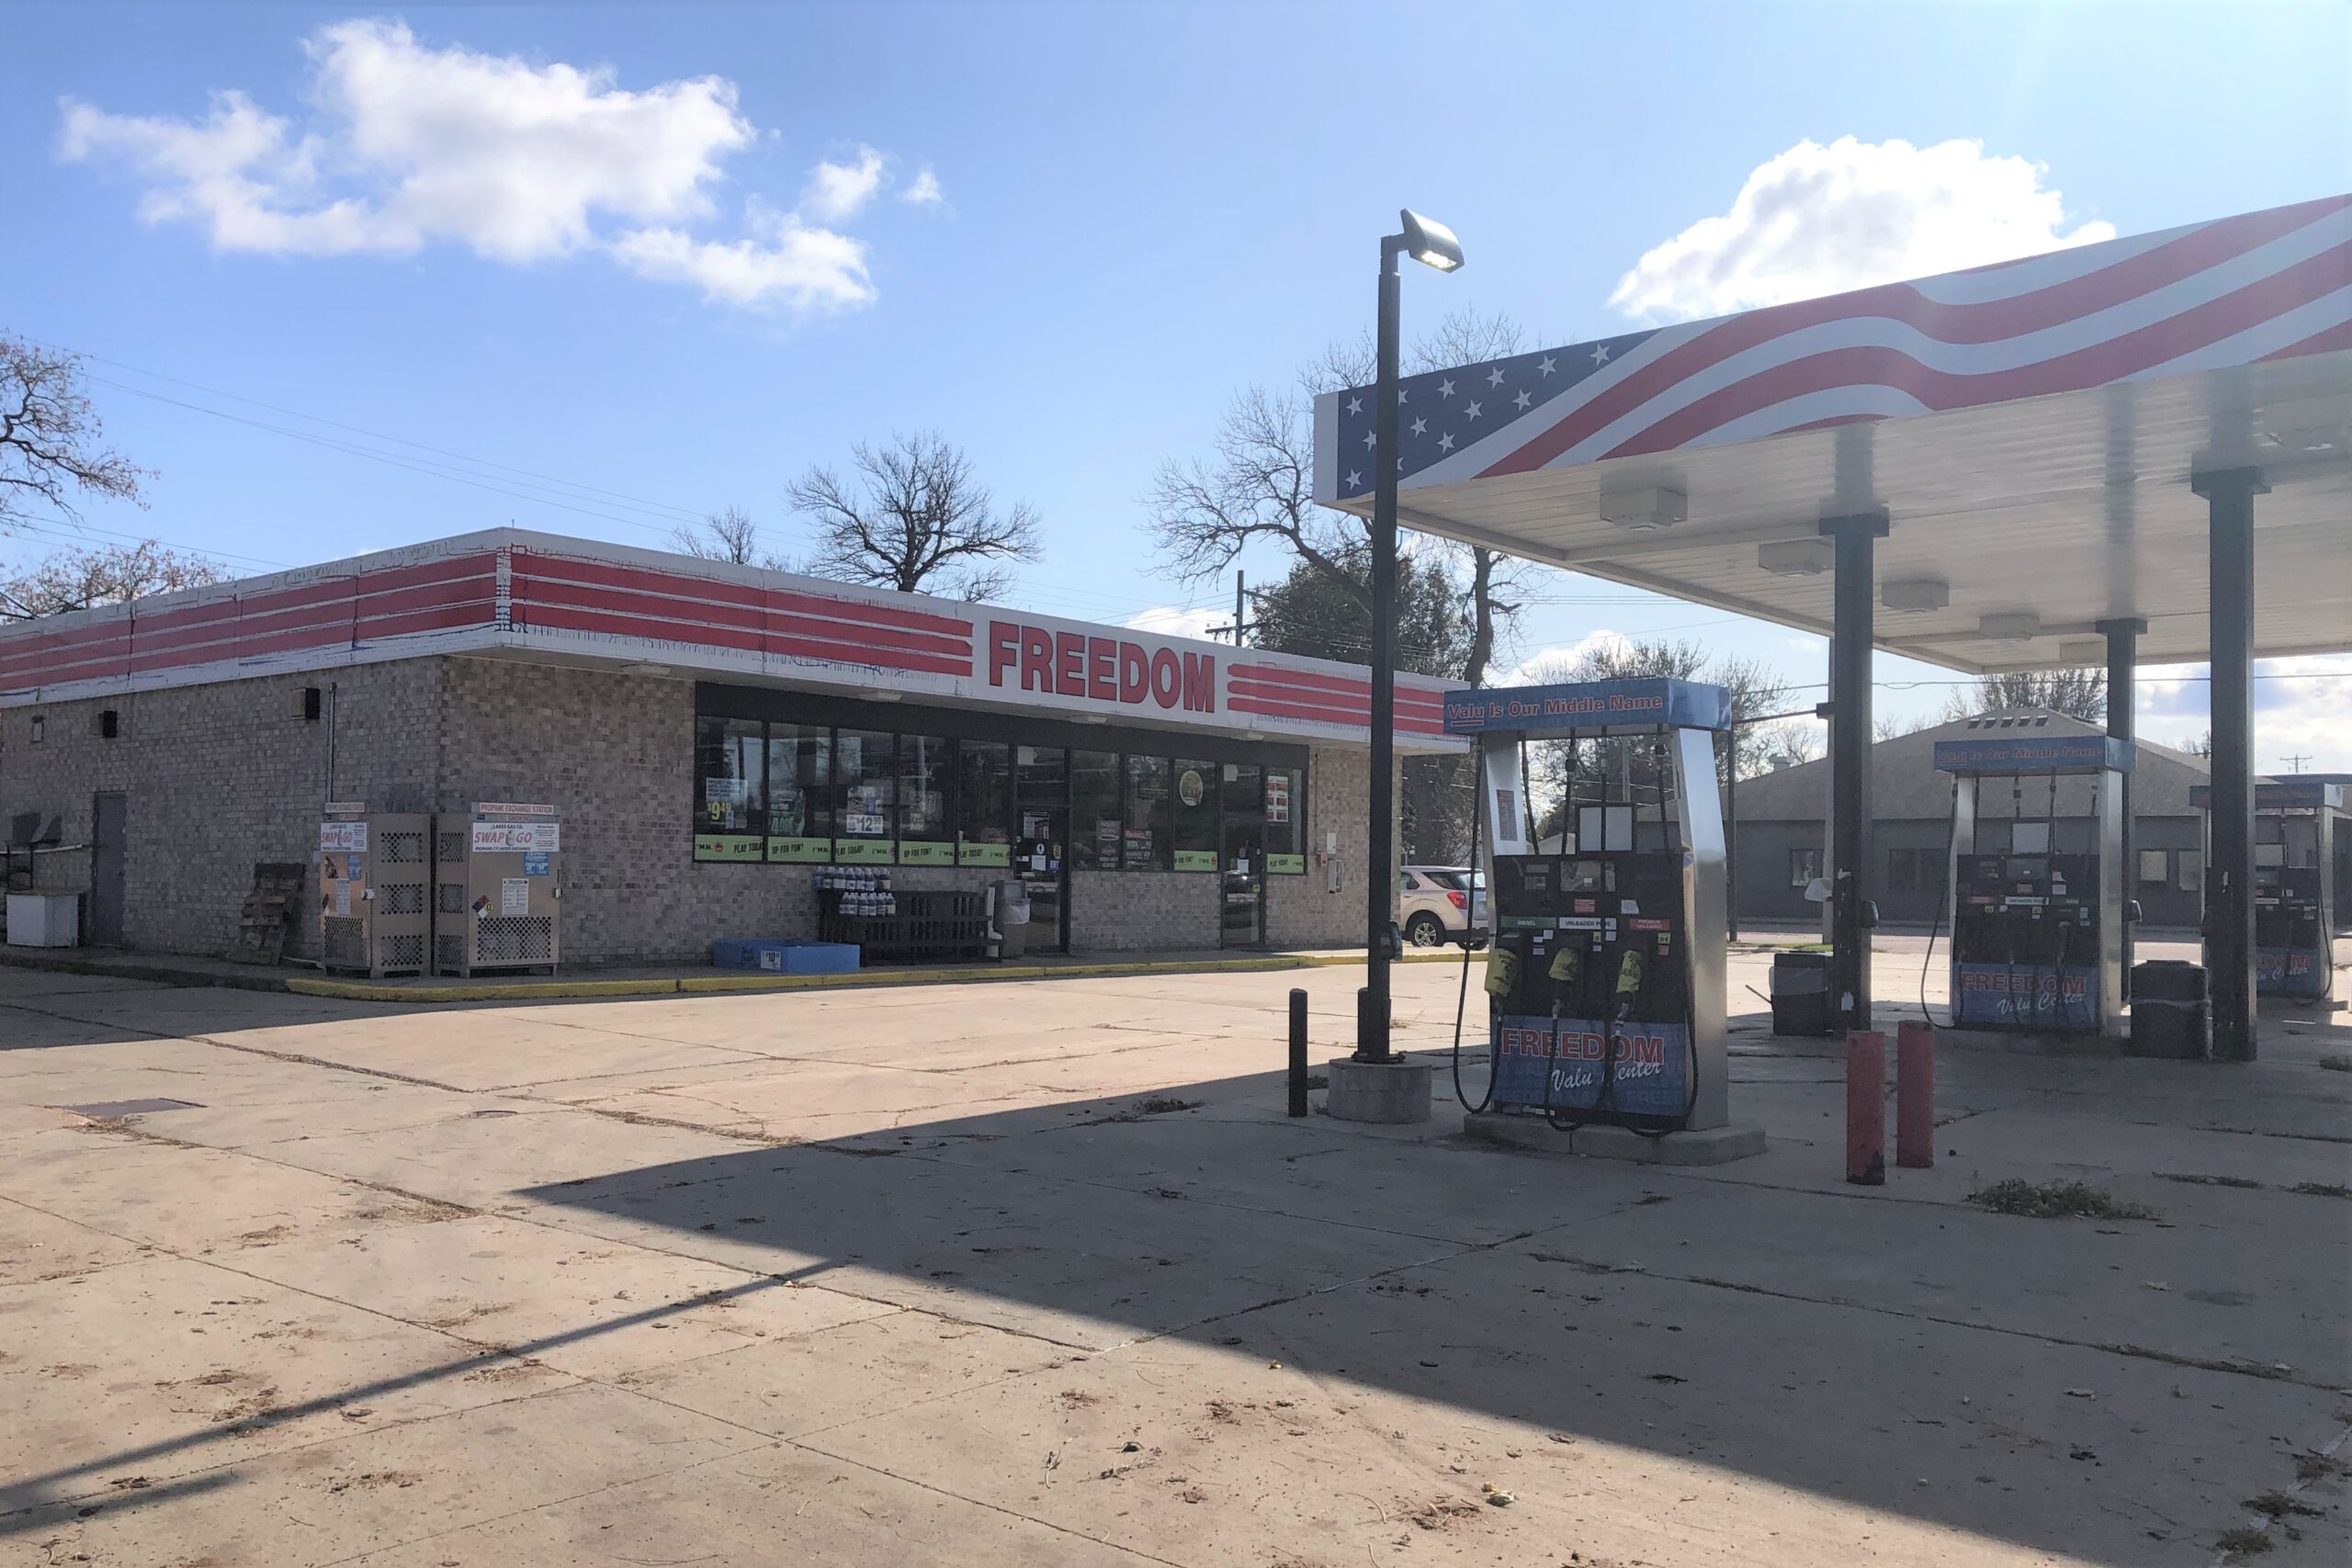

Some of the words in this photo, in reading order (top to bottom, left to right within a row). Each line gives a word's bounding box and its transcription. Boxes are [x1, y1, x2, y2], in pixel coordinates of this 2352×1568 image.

[989, 620, 1215, 713] FREEDOM
[1448, 704, 1484, 719] Valu
[1488, 703, 1504, 717] Is
[1508, 701, 1540, 716] Our
[1544, 696, 1604, 715] Middle
[1609, 694, 1663, 711] Name
[1984, 749, 2008, 761] Our
[2013, 748, 2059, 759] Middle
[2062, 746, 2103, 757] Name
[505, 805, 532, 813] EXCHANGE
[474, 832, 505, 843] SWAP
[516, 831, 532, 843] GO
[733, 843, 747, 853] PLAY
[772, 846, 779, 854] UP
[780, 845, 789, 853] FOR
[791, 843, 804, 852] FUN?
[1502, 1028, 1664, 1065] FREEDOM
[1551, 1067, 1593, 1091] Valu
[1601, 1062, 1662, 1082] enter
